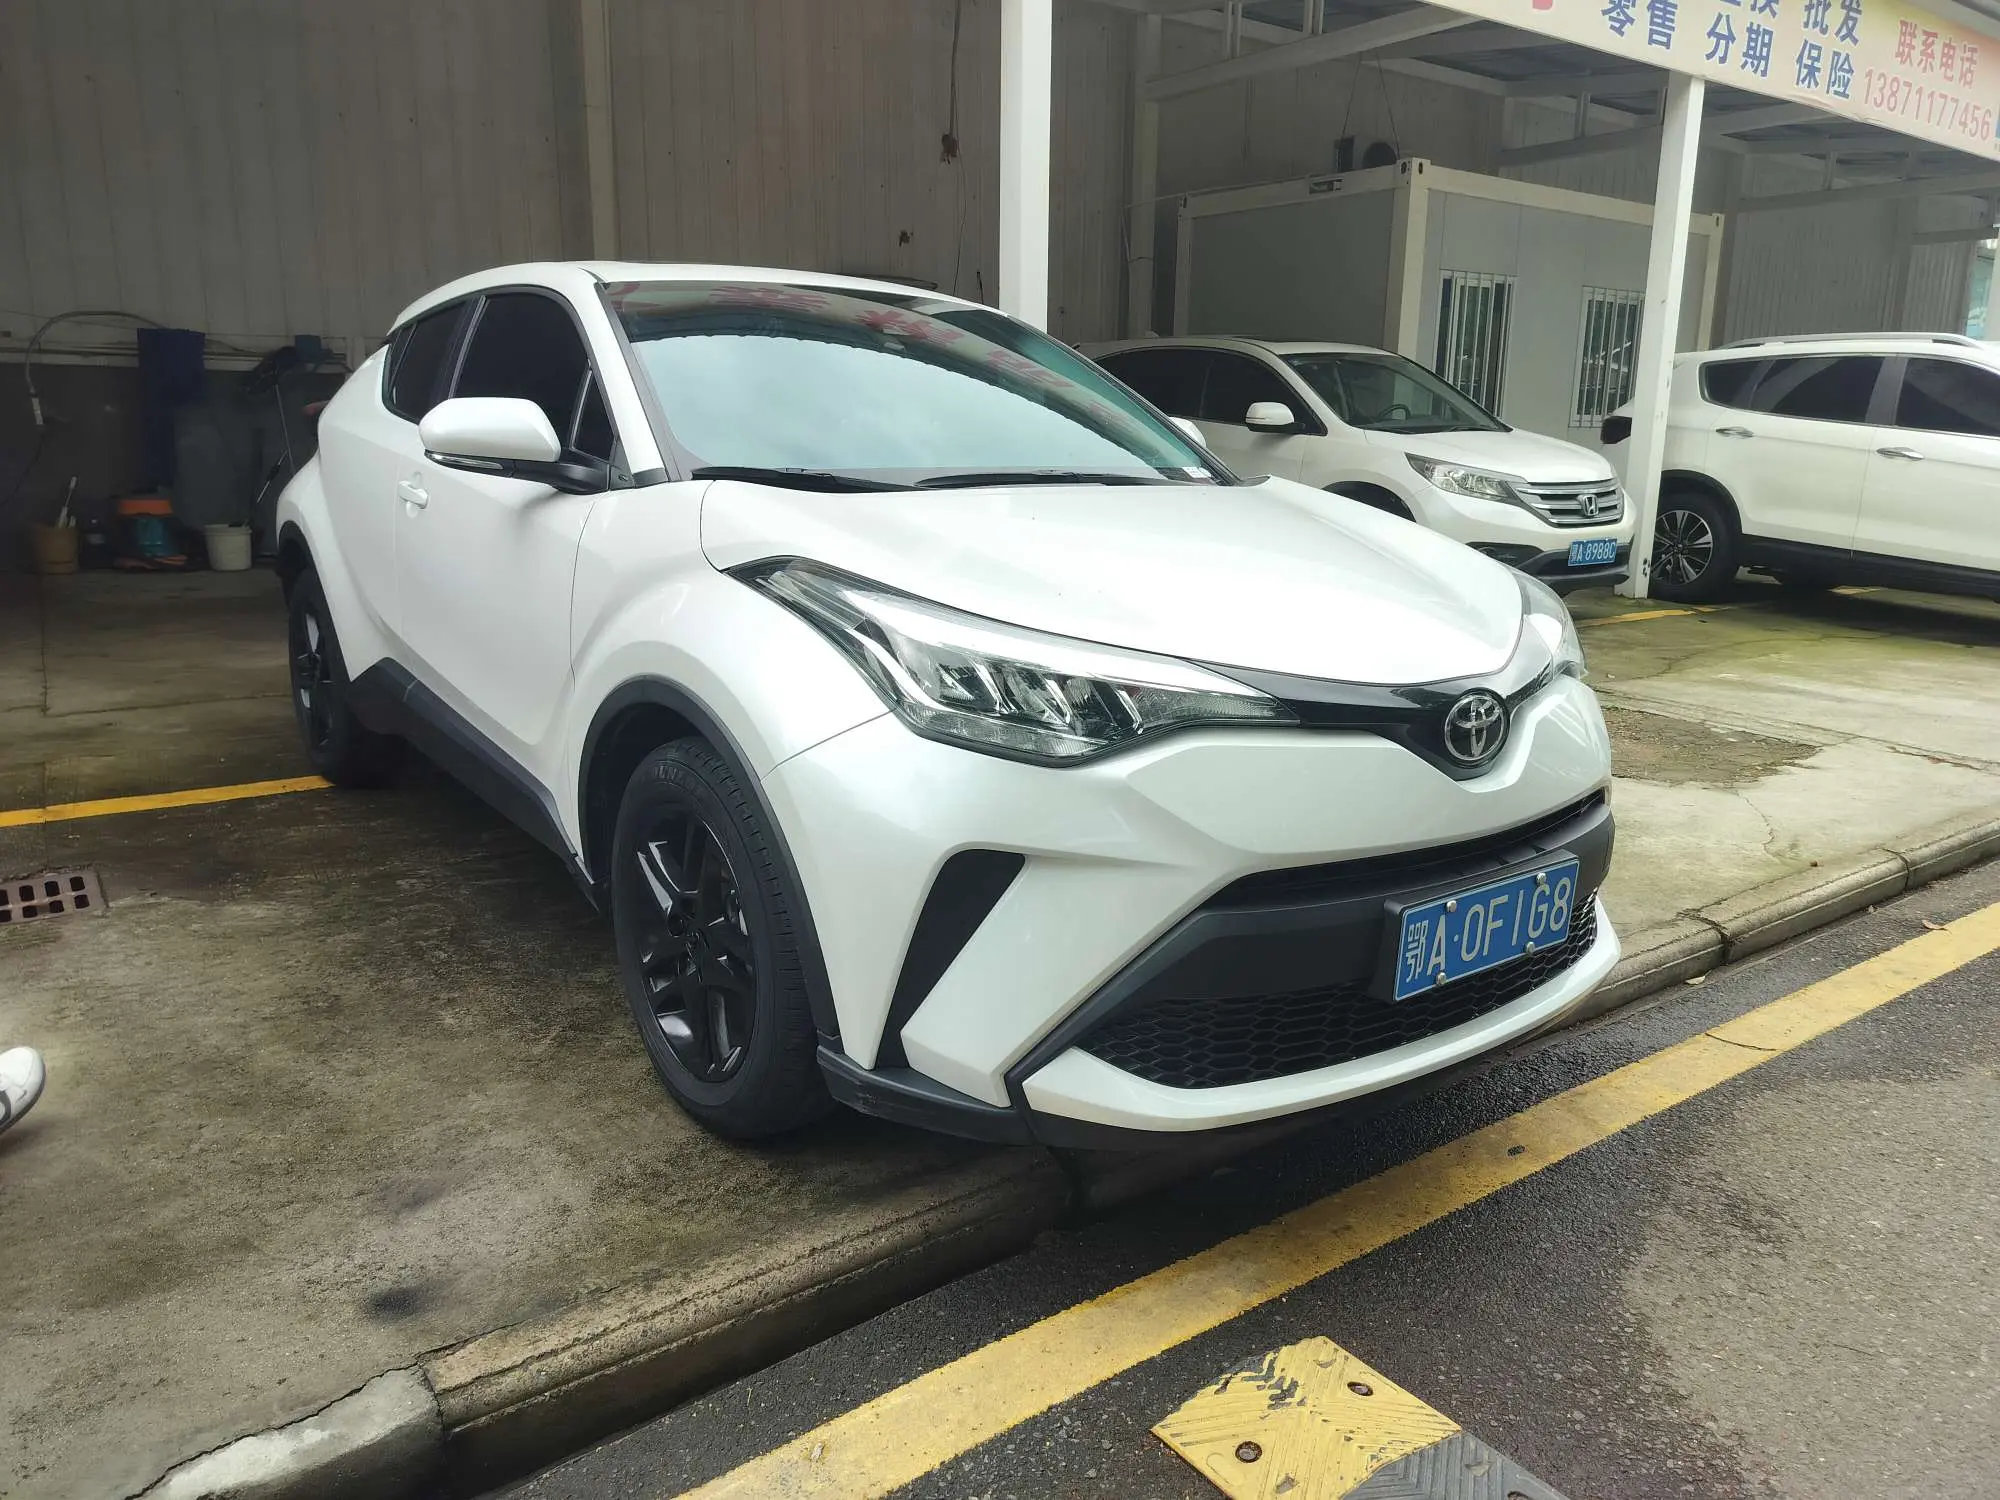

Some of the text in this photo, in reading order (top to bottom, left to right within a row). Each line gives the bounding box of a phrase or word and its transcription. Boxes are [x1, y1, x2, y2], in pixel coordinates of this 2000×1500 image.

[1705, 12, 1773, 77] 分期
[1795, 39, 1854, 100] 保险
[1803, 0, 1862, 46] 批发
[1895, 19, 1978, 89] 联系电话
[1864, 69, 1991, 141] 13871177456
